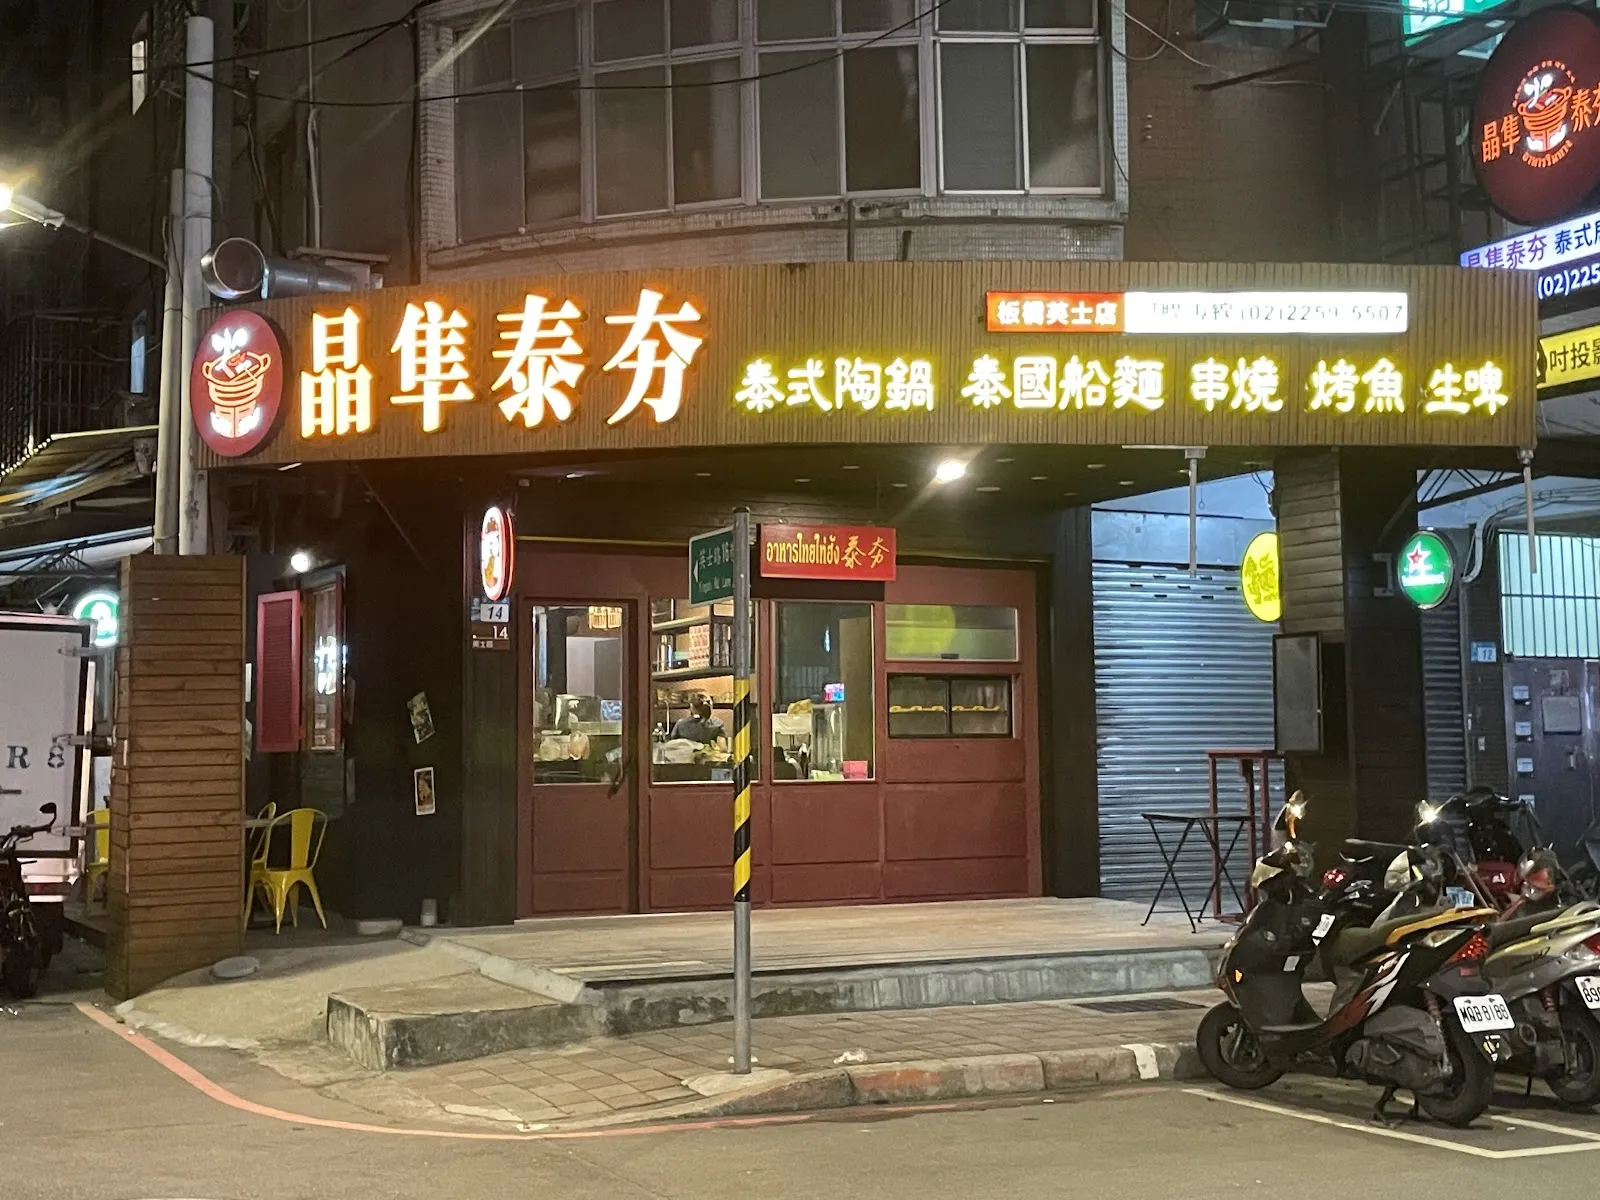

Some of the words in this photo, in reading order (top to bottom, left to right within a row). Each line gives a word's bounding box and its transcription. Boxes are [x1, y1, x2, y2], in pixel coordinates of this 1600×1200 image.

[1482, 113, 1521, 163] 晶隼
[300, 288, 703, 439] 晶隼泰夯
[735, 356, 934, 413] 泰式陶鍋
[961, 354, 1165, 411] 泰國船麵
[1190, 355, 1284, 412] 串燒
[1310, 357, 1405, 413] 烤魚
[1425, 360, 1509, 415] 生啤
[841, 535, 890, 569] 泰夯
[488, 606, 503, 620] 14
[493, 625, 508, 639] 14
